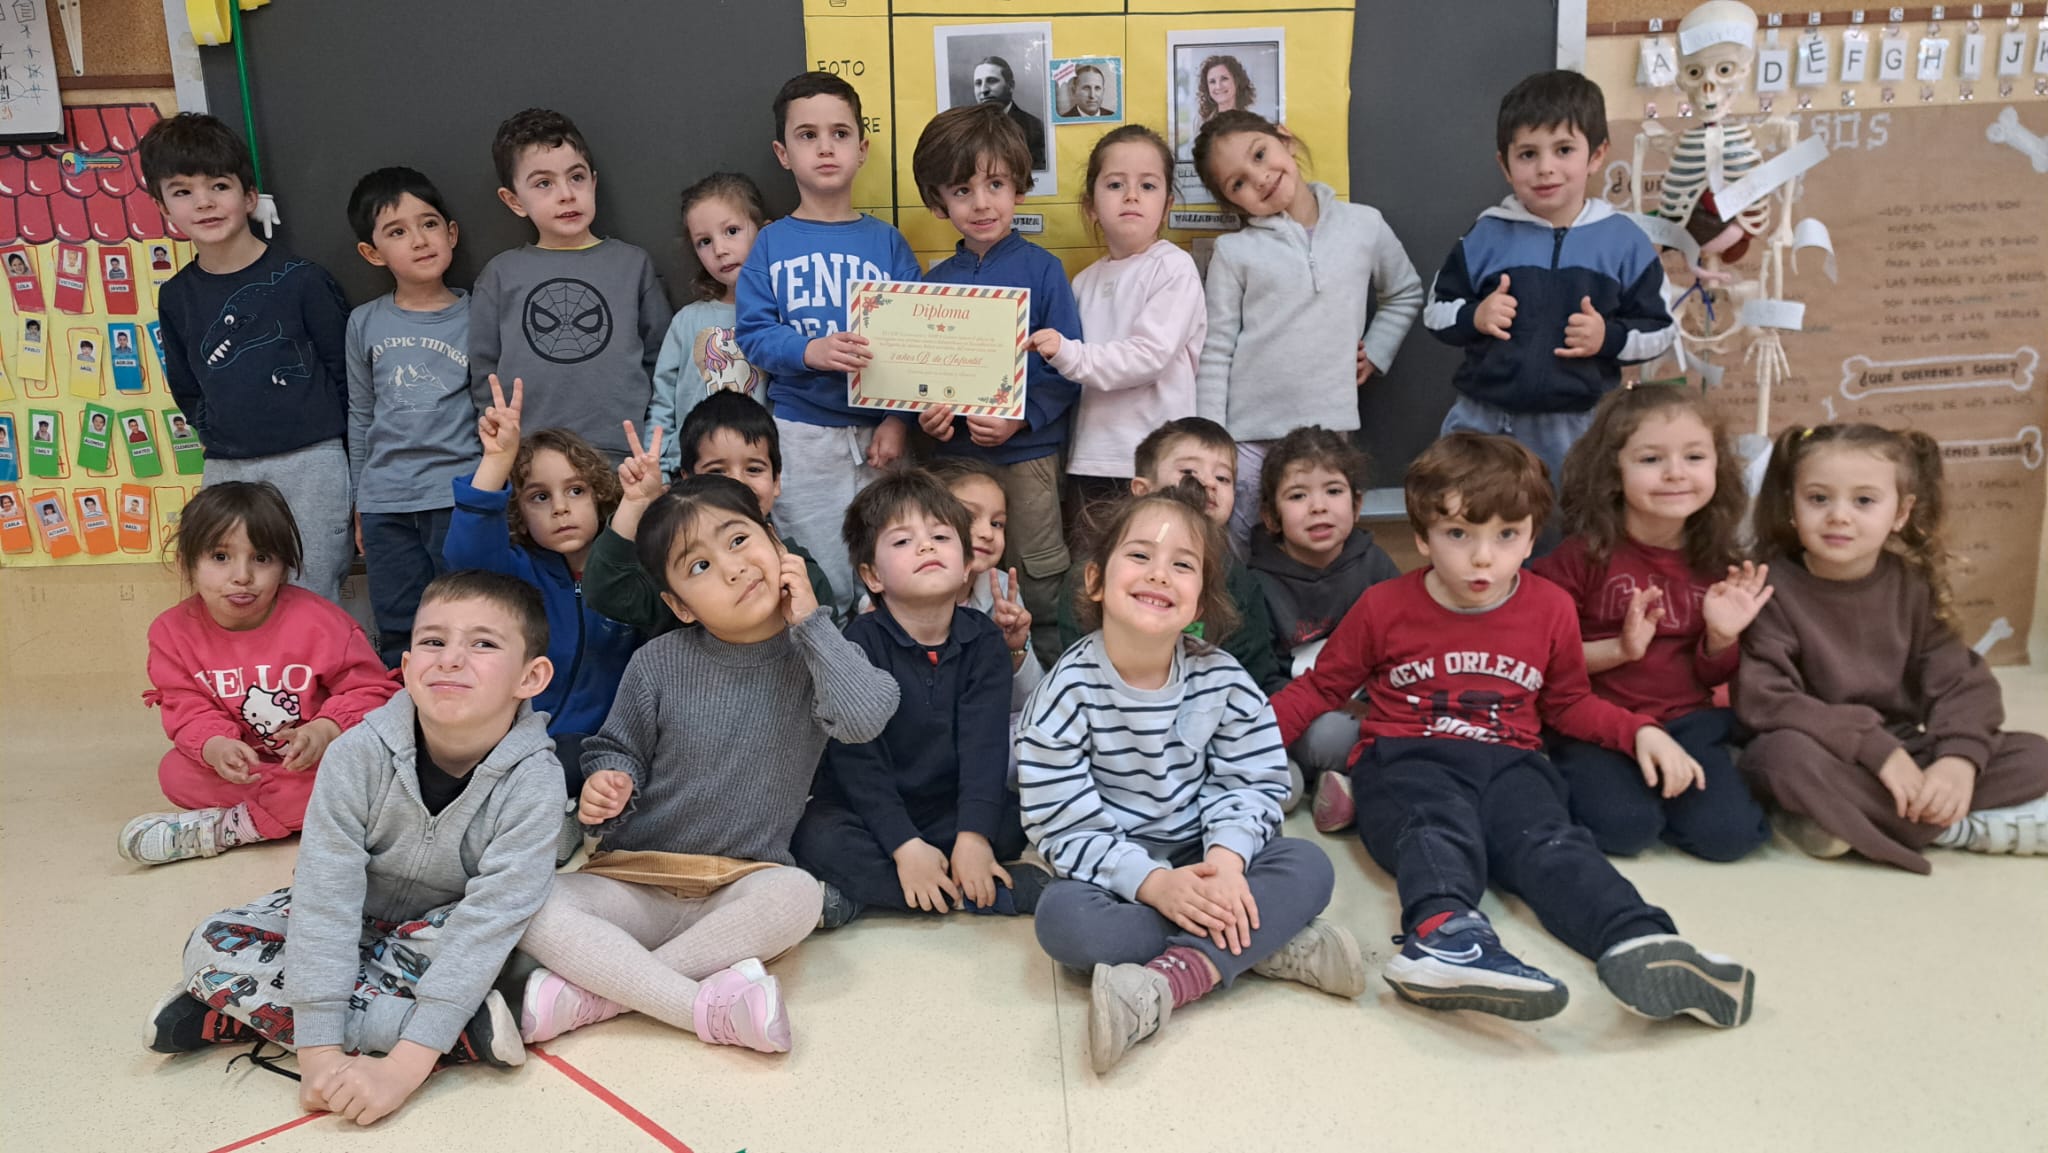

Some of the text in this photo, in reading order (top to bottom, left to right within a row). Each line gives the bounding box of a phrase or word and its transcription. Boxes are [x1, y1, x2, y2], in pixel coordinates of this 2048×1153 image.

[817, 60, 865, 77] FOTO
[1652, 53, 1671, 74] A
[1763, 61, 1783, 83] D
[1808, 40, 1826, 63] E
[1848, 50, 1863, 71] F
[1885, 48, 1903, 71] G
[1923, 48, 1943, 70] H
[2005, 40, 2023, 64] J
[912, 303, 972, 321] Diploma
[383, 336, 416, 348] EPIC
[420, 337, 470, 368] THINGS
[1389, 656, 1435, 689] NEW
